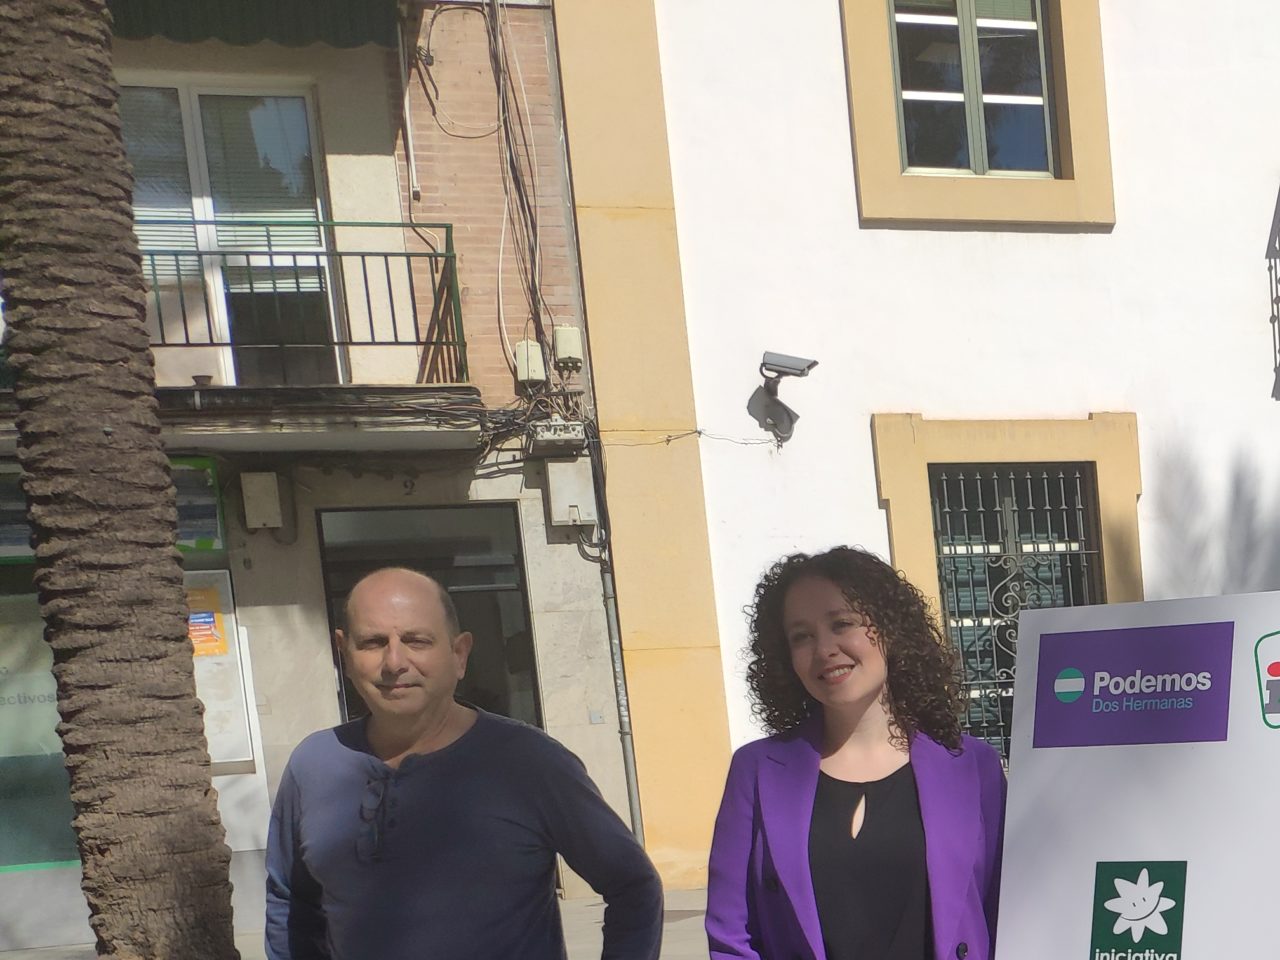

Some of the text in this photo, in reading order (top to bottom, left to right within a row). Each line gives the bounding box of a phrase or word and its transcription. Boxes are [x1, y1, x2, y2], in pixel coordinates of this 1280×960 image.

[1093, 669, 1212, 696] Podemos
[1092, 696, 1193, 713] Dos Hermanas
